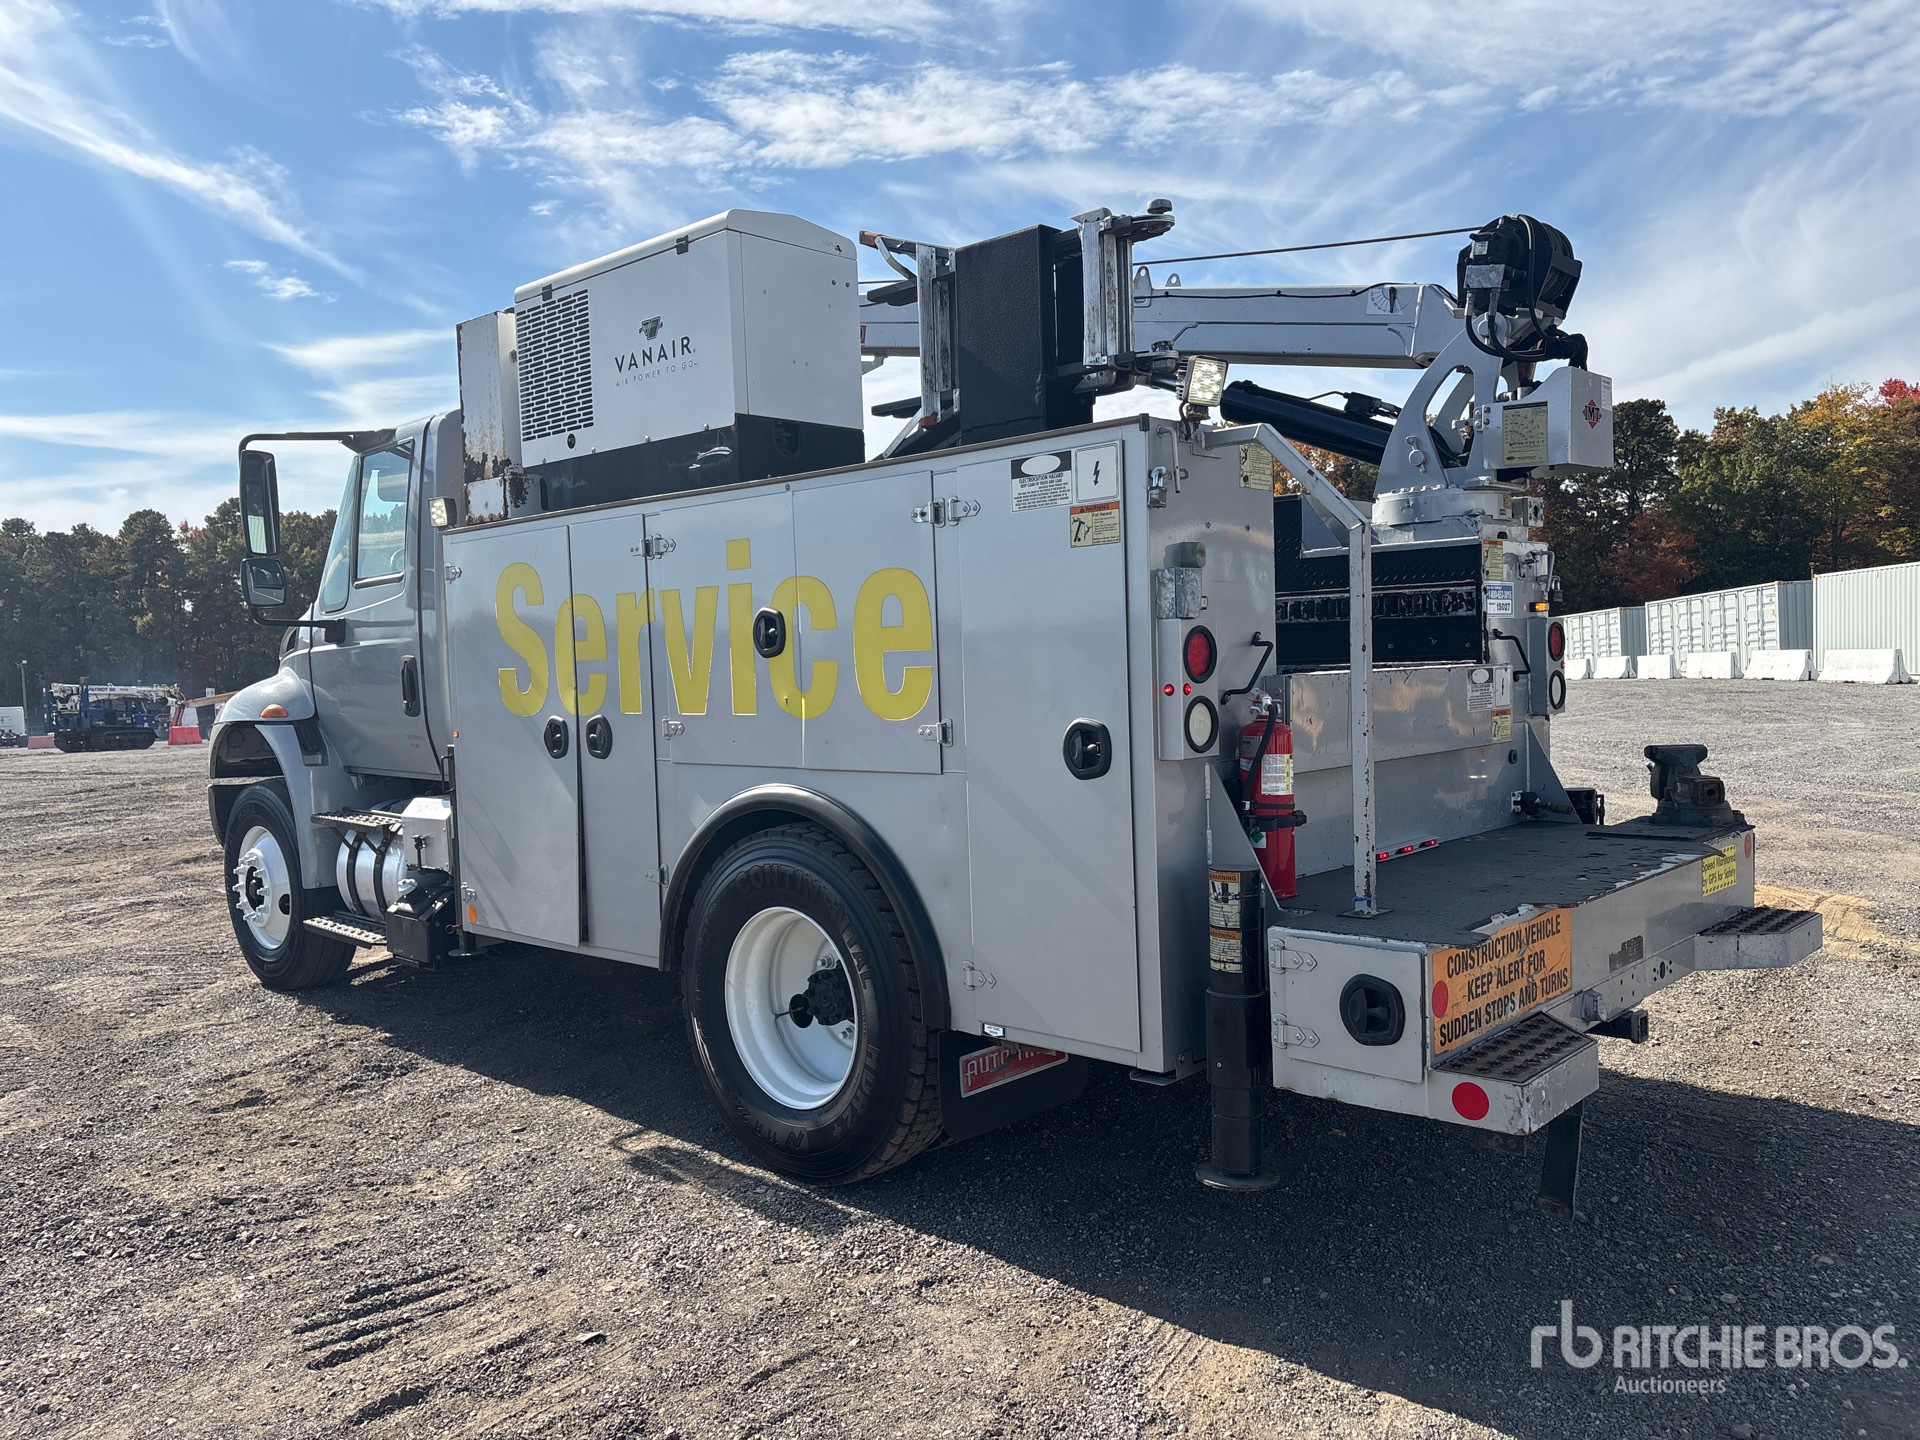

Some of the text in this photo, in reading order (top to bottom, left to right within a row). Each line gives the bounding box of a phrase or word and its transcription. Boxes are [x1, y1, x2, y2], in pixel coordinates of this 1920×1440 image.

[615, 336, 692, 373] VANAIR
[616, 378, 628, 387] AIR
[633, 369, 661, 382] POWER
[666, 365, 676, 373] TO
[1584, 405, 1600, 422] IMT
[1019, 472, 1064, 484] ELECTROCUTION HAZARD
[1084, 503, 1110, 512] WARNING
[496, 538, 933, 722] Service
[1708, 872, 1717, 884] GPS
[1724, 866, 1736, 879] Safety
[1447, 914, 1561, 979] CONSTRUCTION VEHICLE
[1467, 949, 1546, 1002] KEEP ALERT FOR
[1440, 967, 1569, 1047] SUDDEN STOPS AND TURNS
